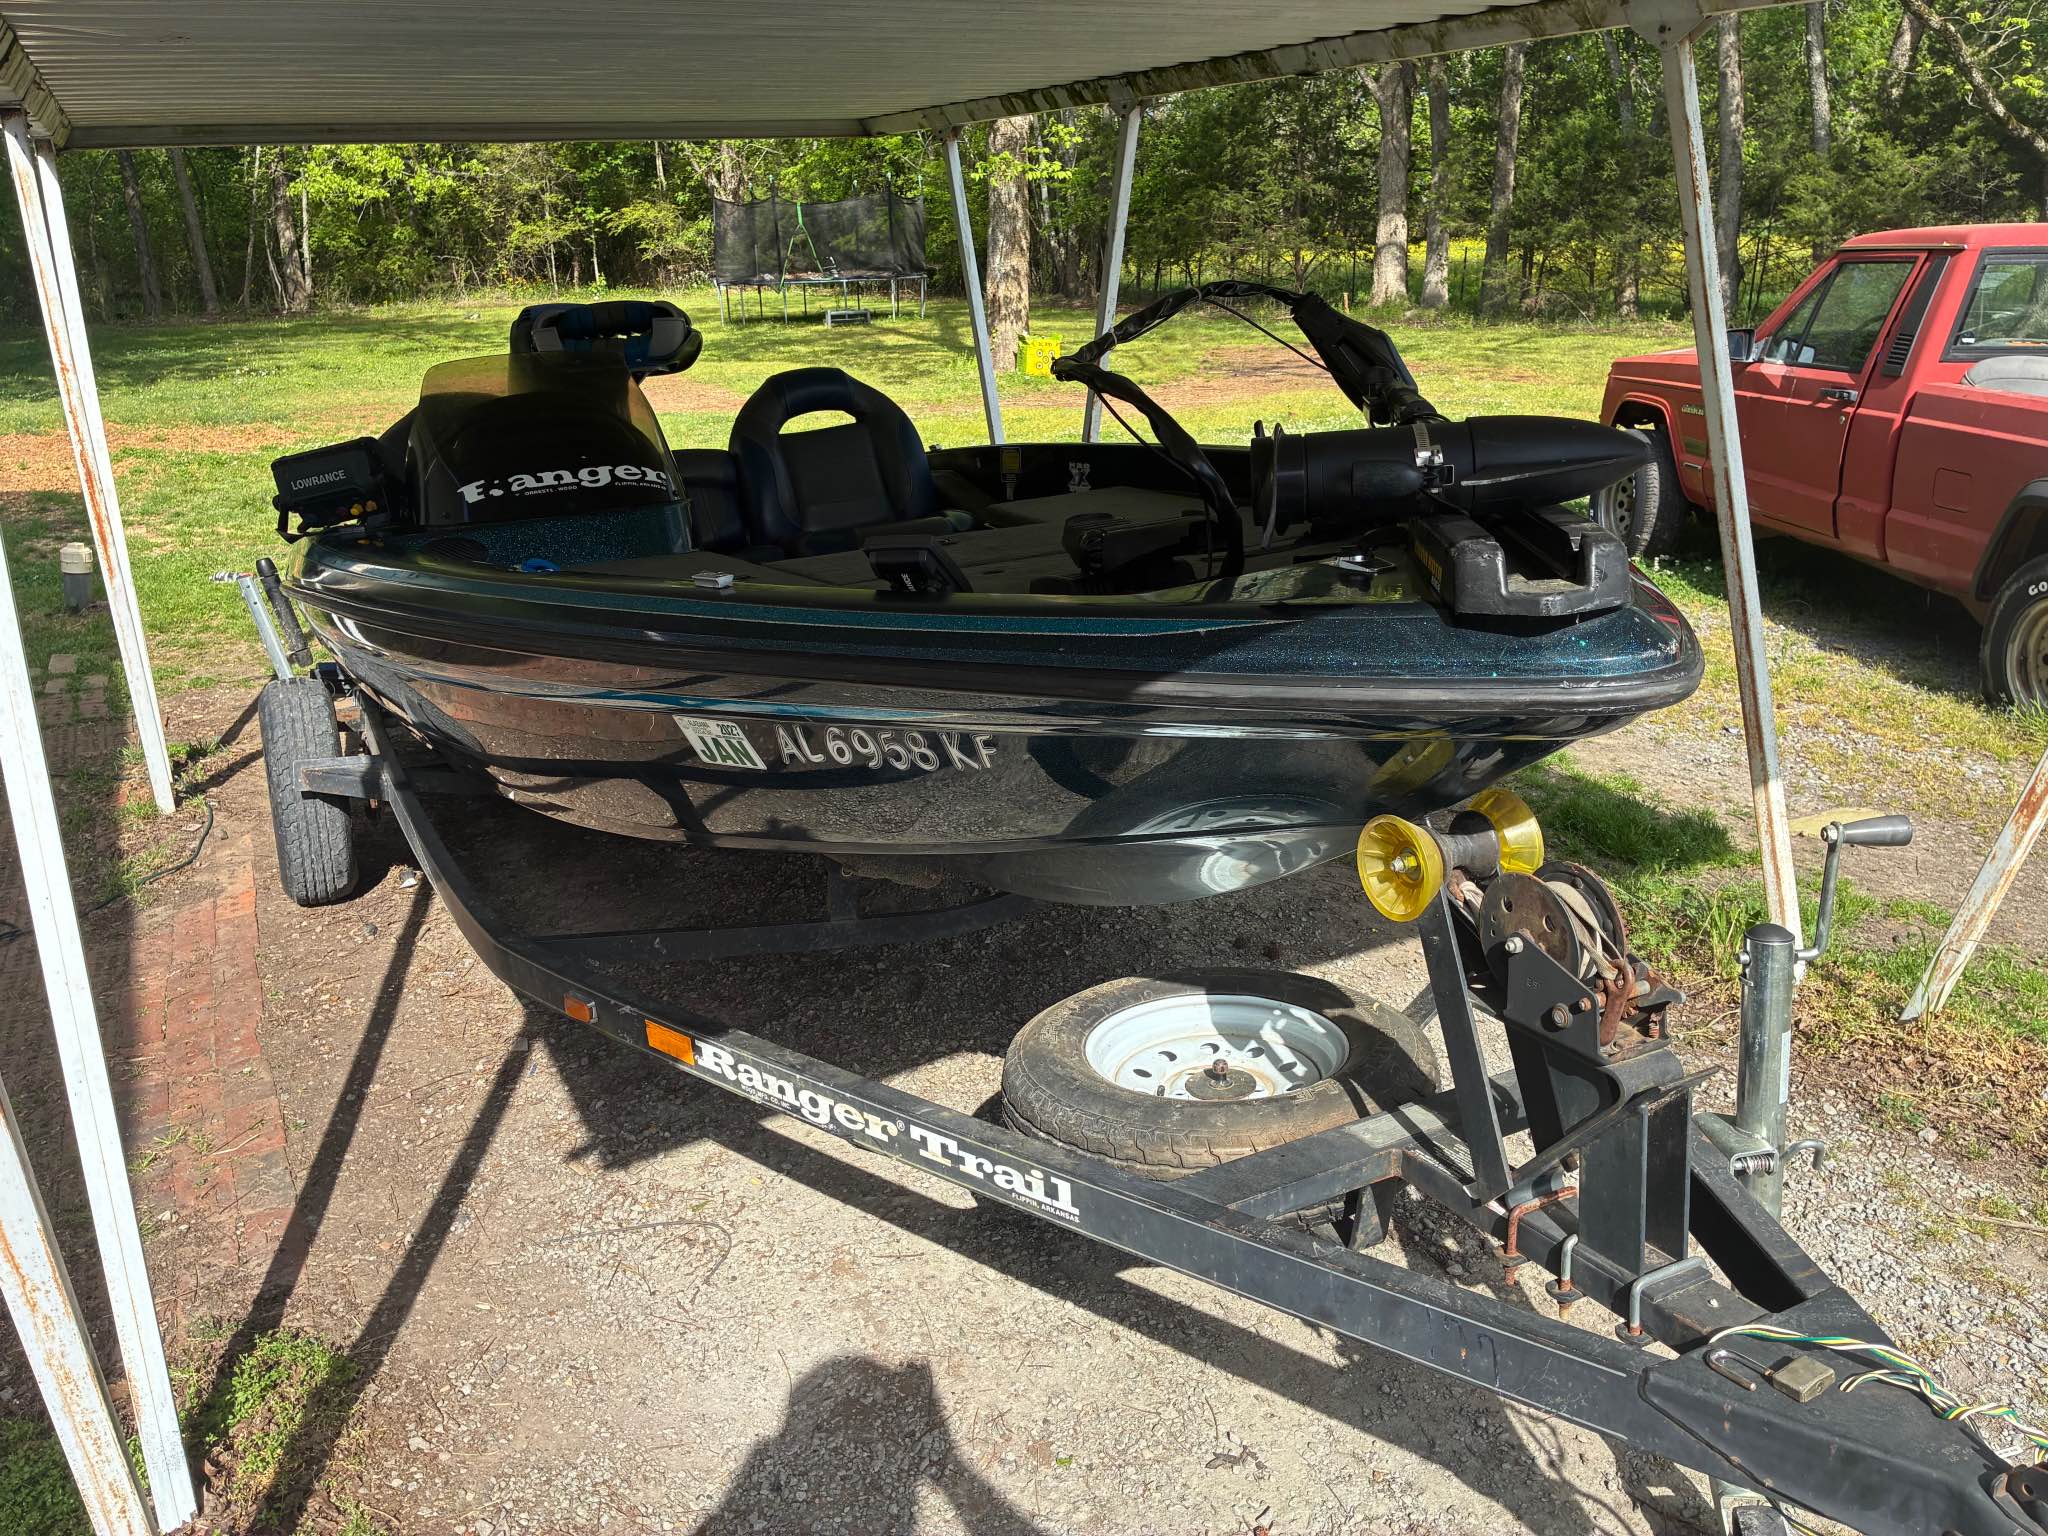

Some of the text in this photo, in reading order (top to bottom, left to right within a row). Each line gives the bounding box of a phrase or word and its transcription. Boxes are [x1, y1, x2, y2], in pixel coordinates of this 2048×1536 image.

[290, 469, 347, 490] LOWRANCE
[698, 735, 759, 767] JAN
[909, 1124, 1080, 1216] Trail
[1041, 1203, 1080, 1223] ARKANSAS
